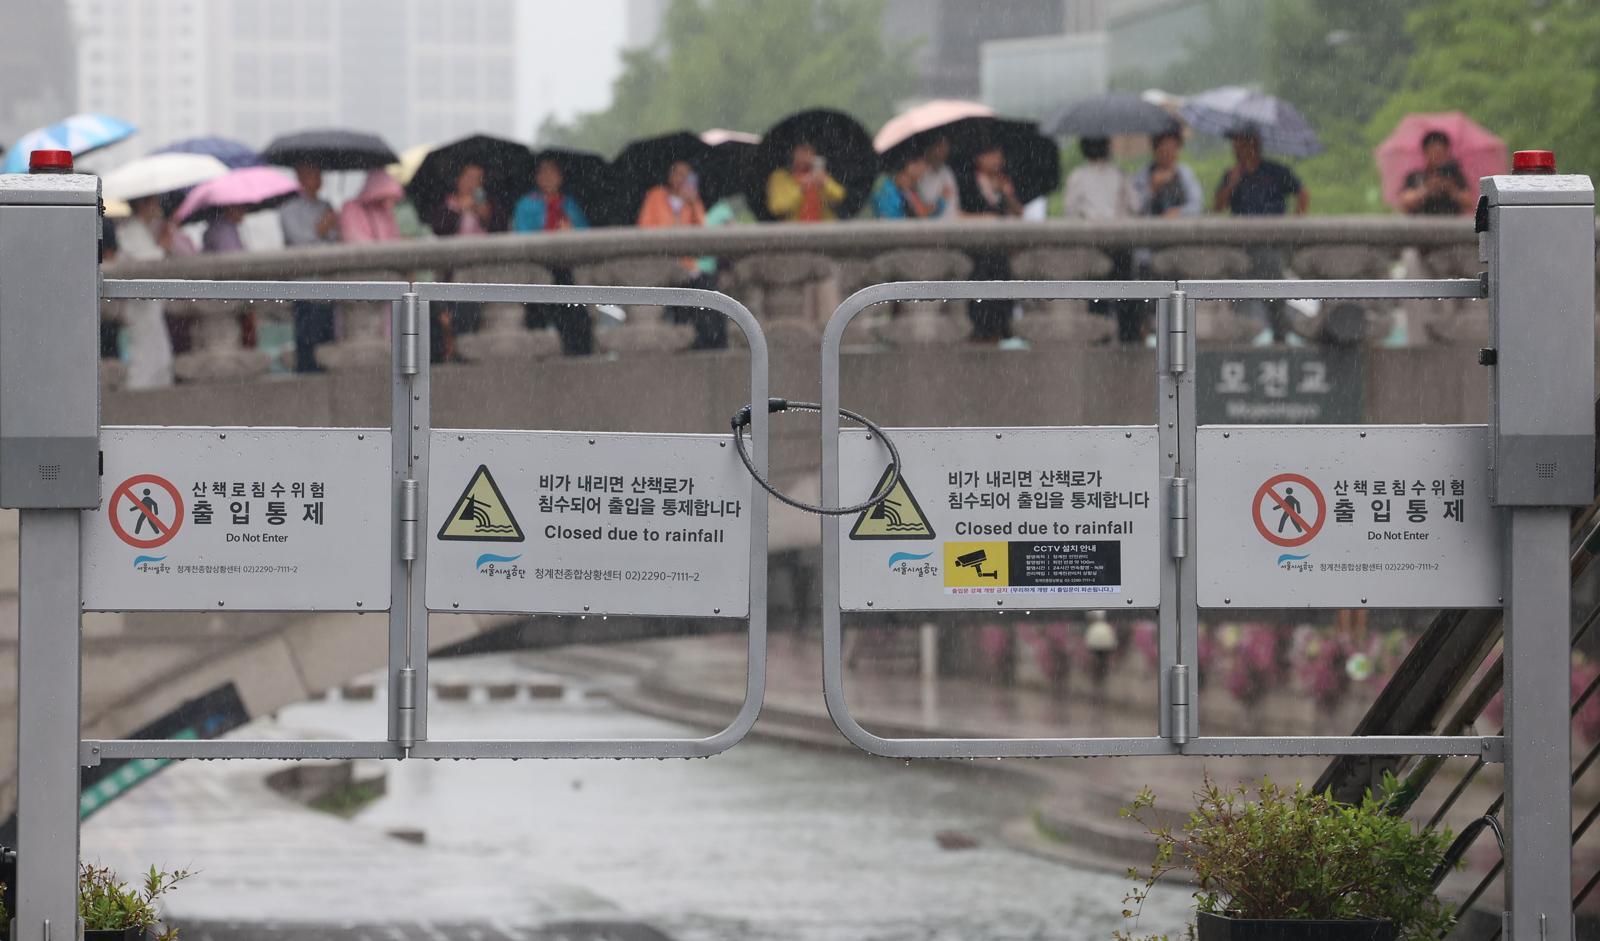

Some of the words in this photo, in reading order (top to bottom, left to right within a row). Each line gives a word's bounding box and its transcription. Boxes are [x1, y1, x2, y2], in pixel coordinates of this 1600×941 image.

[539, 474, 571, 492] 비가
[577, 475, 624, 494] 내리면
[631, 476, 694, 496] 산책로가
[949, 471, 980, 488] 비가
[986, 470, 1033, 488] 내리면
[1039, 469, 1103, 488] 산책로가
[538, 495, 601, 515] 침수되어
[608, 496, 656, 516] 출입을
[661, 498, 742, 518] 통제합니다
[948, 492, 1011, 510] 침수되어
[1017, 491, 1065, 509] 출입을
[1070, 490, 1150, 509] 통제합니다
[544, 524, 602, 541] Closed
[607, 526, 638, 541] due
[642, 527, 660, 542] to
[665, 528, 724, 543] rainfall
[955, 521, 1013, 535] Closed
[1018, 521, 1048, 535] due
[1052, 522, 1070, 535] to
[1074, 520, 1134, 535] rainfall
[226, 533, 240, 543] Do
[242, 533, 260, 543] Not
[263, 533, 289, 543] Enter
[1367, 531, 1382, 541] Do
[1384, 531, 1402, 541] Not
[1403, 531, 1430, 541] Enter
[1062, 544, 1078, 552] 설치
[1079, 544, 1097, 552] 안내
[137, 561, 171, 574] 서울시설공단
[480, 563, 526, 579] 서울시설공단
[892, 562, 939, 578] 서울시설공단
[1281, 560, 1314, 573] 서울시설공단
[534, 568, 622, 582] 청계천종합상황센터
